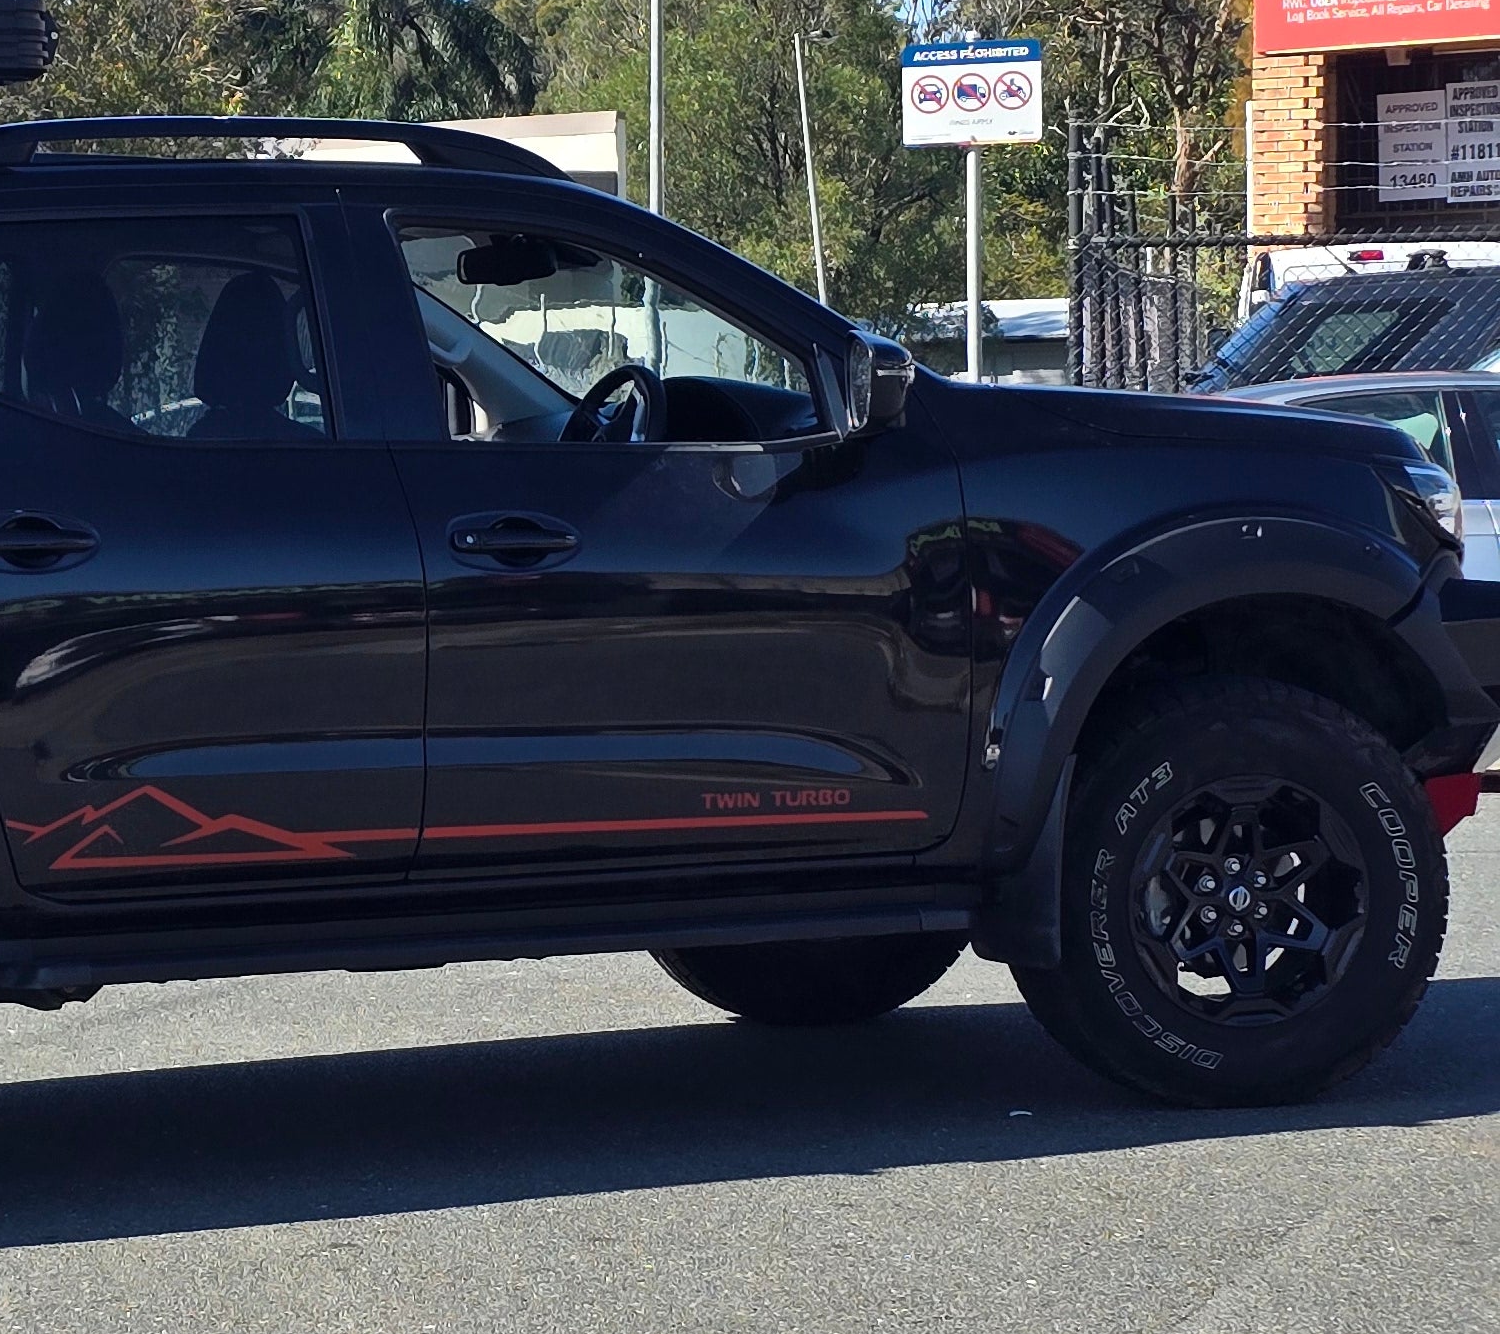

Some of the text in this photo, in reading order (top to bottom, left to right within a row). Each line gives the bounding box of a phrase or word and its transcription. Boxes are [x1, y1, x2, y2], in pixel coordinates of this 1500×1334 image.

[1371, 3, 1385, 15] All
[1427, 0, 1442, 11] Car
[913, 50, 957, 61] ACCESS
[1452, 85, 1498, 101] APPROVED
[1385, 102, 1438, 114] APPROVED
[1458, 120, 1493, 134] STATION
[1393, 142, 1433, 153] STATION
[702, 789, 851, 809] TWIN TURBO
[1359, 781, 1419, 969] COOPER
[1090, 761, 1224, 1069] DISCOVERER AT3
